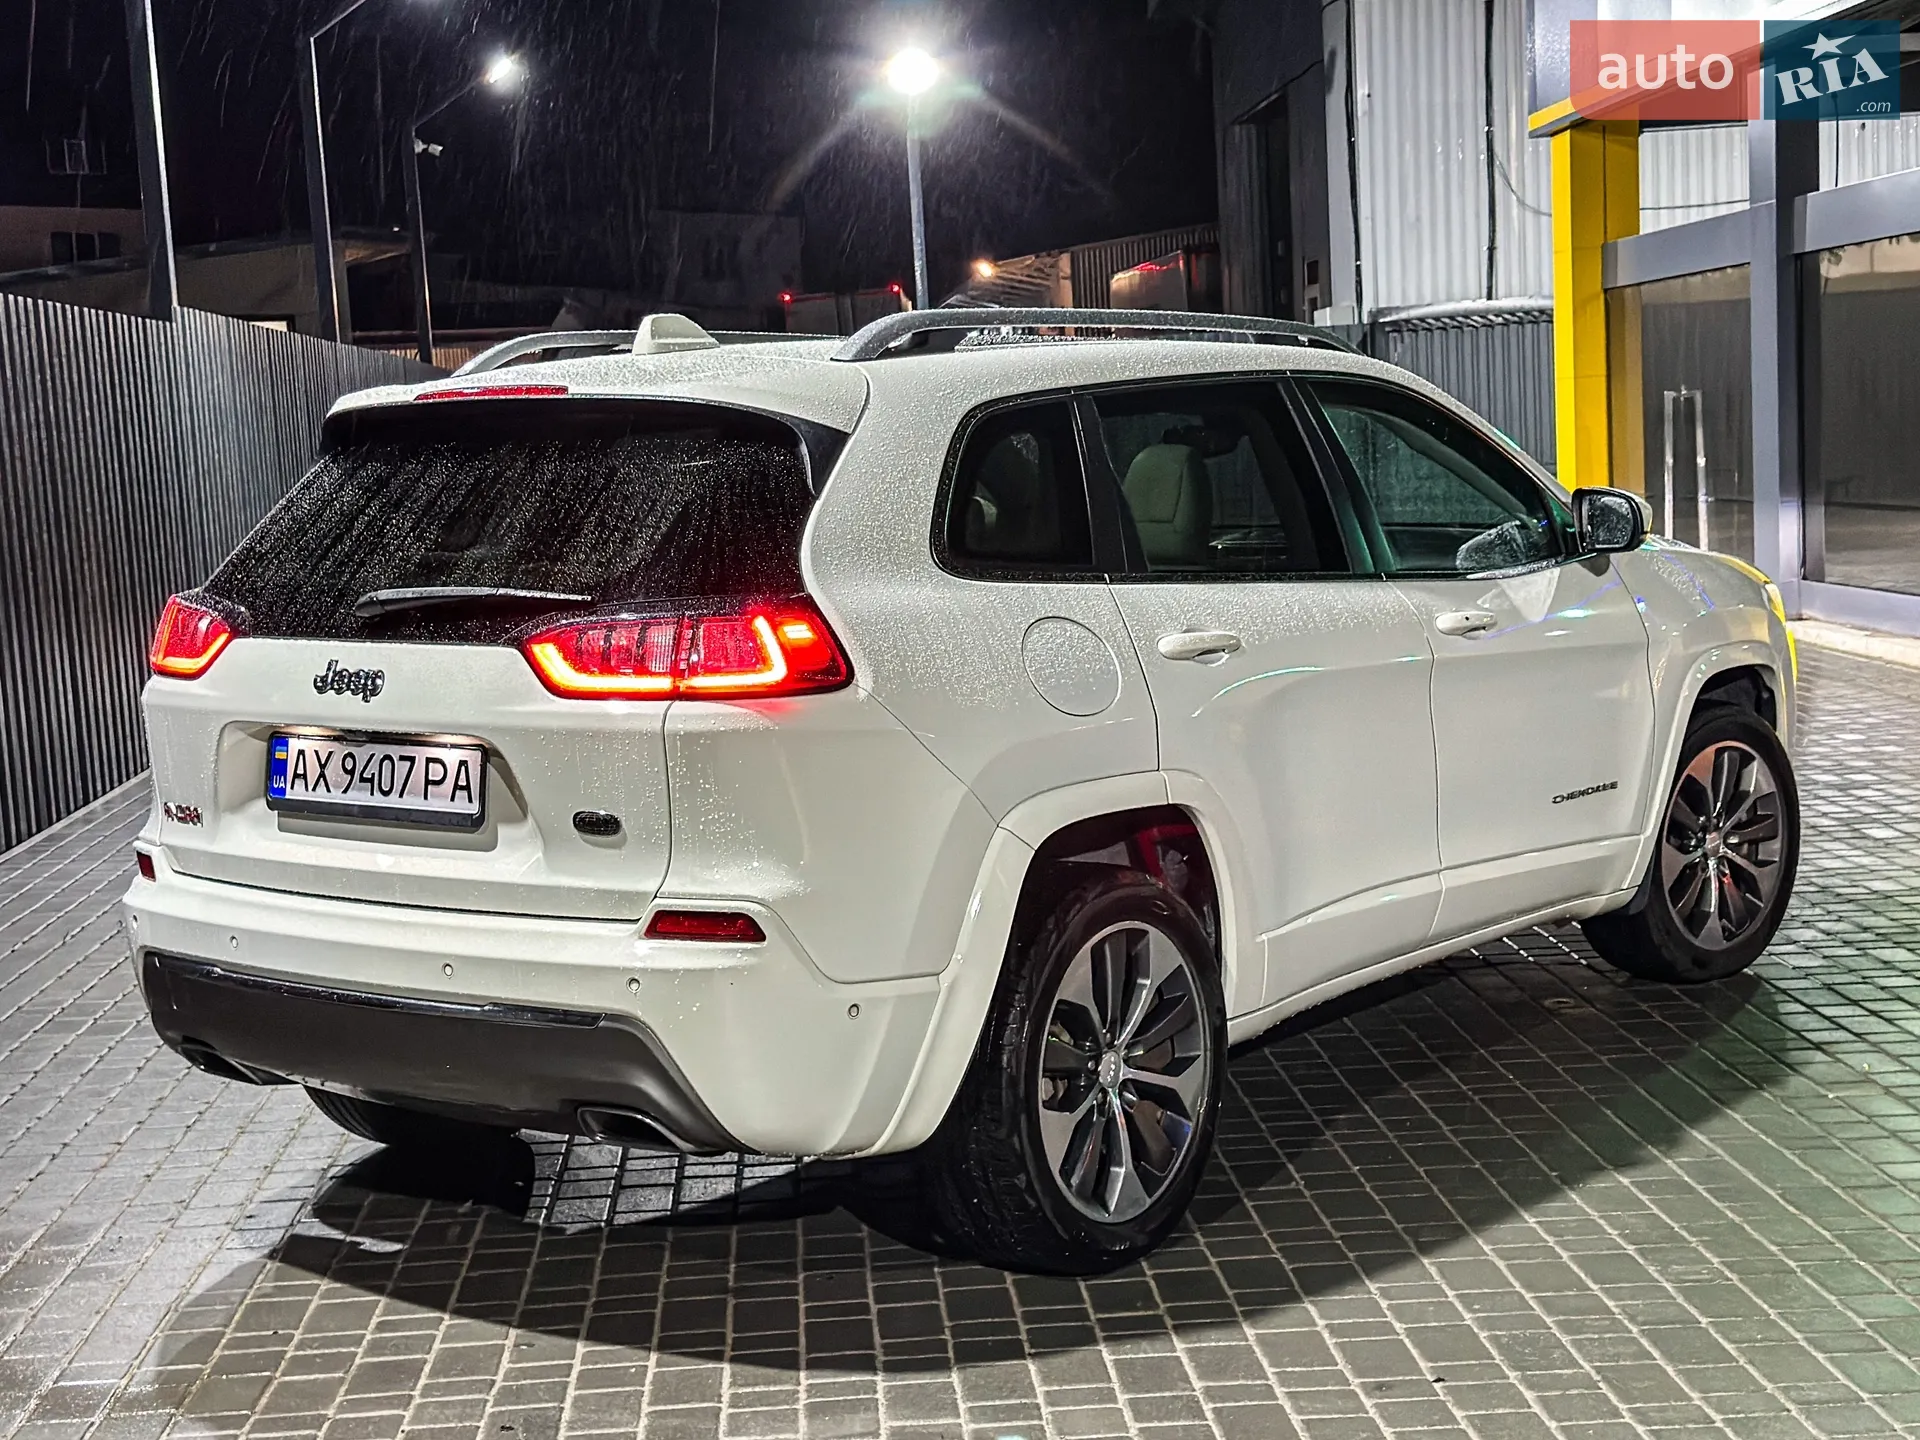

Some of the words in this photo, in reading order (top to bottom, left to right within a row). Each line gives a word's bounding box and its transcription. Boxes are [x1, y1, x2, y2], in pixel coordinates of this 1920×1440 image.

[313, 659, 385, 703] Jeep
[273, 775, 286, 789] UA
[341, 751, 417, 799] 9407
